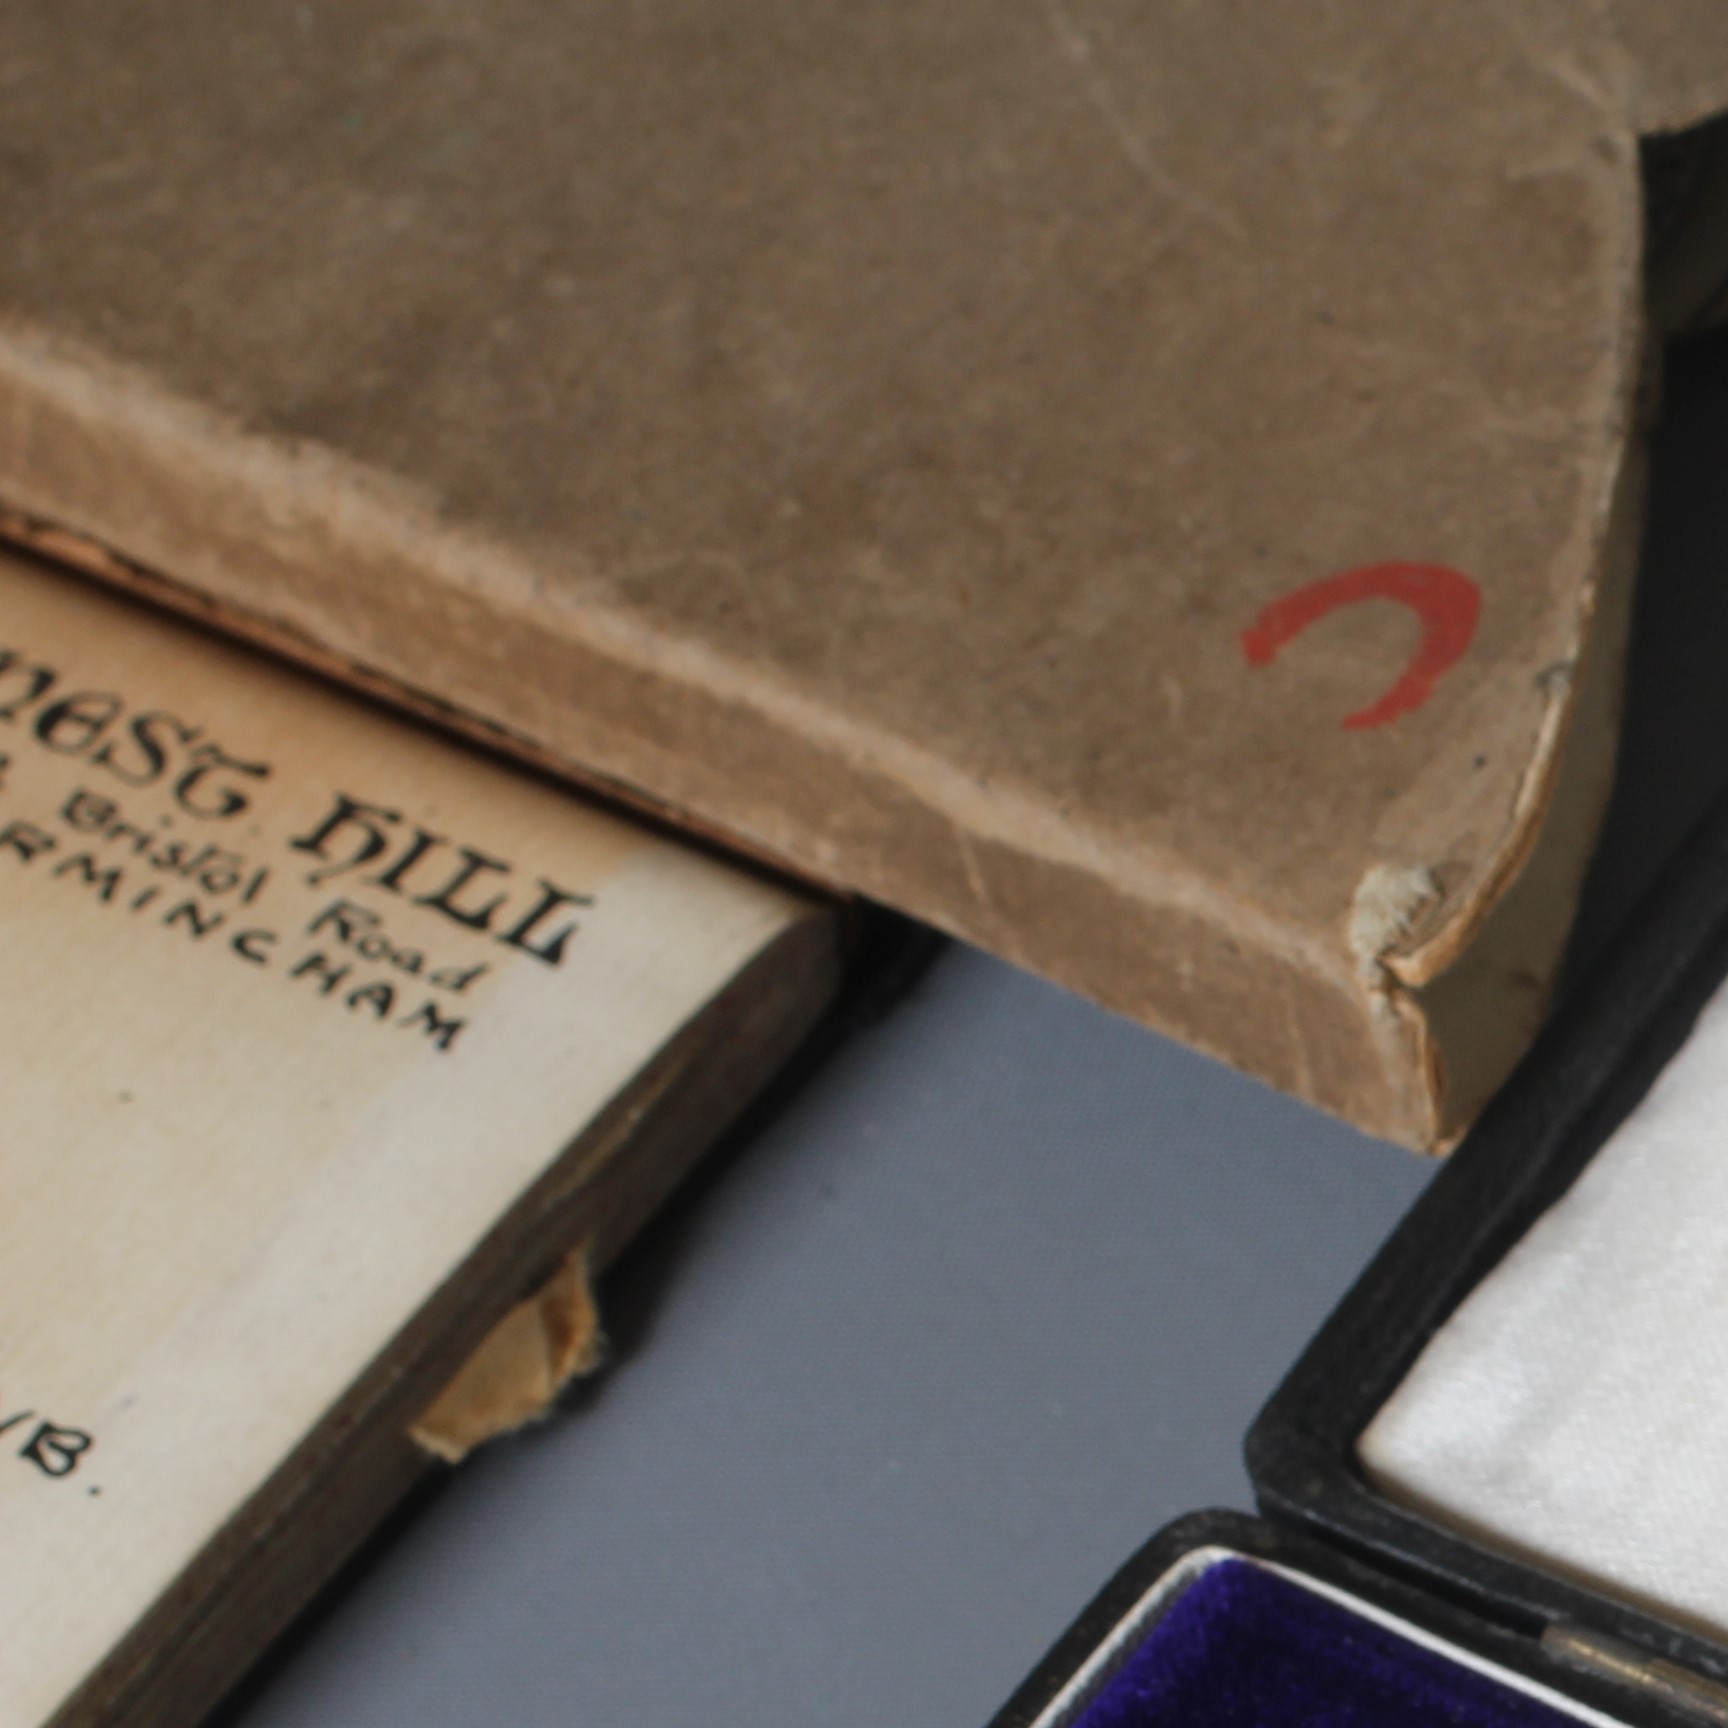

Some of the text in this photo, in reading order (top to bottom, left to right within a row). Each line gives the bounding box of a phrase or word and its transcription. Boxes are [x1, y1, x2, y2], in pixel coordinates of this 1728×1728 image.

[60, 786, 492, 995] Bristol Road
[289, 788, 596, 970] HILL
